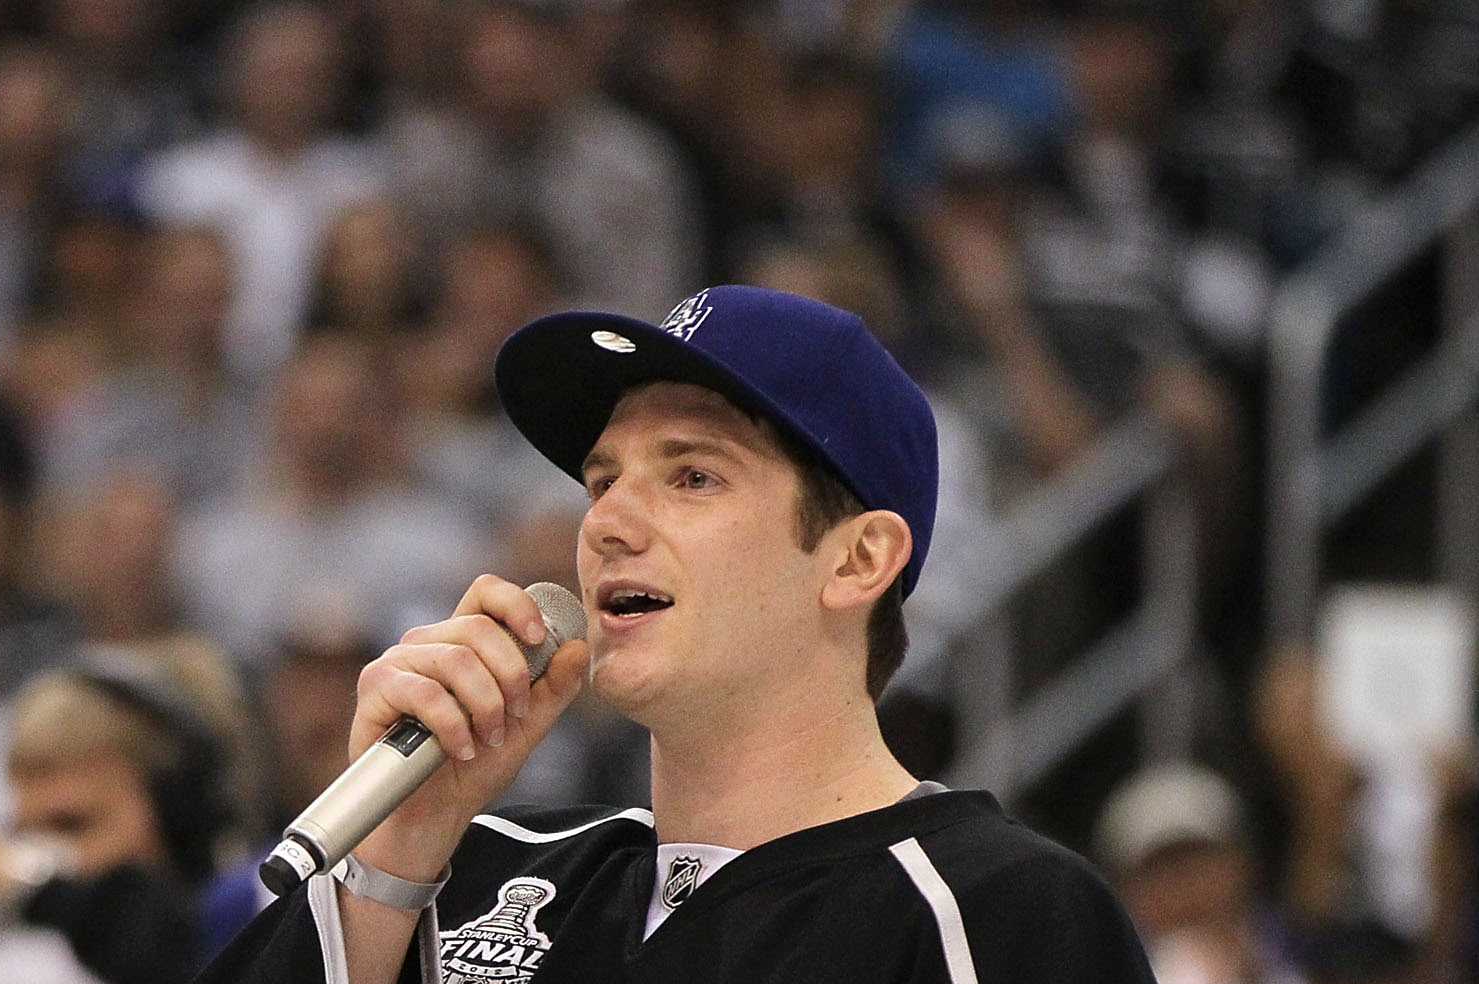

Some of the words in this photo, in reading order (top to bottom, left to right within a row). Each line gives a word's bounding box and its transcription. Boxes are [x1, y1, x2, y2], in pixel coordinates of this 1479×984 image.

[668, 869, 694, 898] NHL
[458, 930, 511, 942] STANLEY
[510, 937, 538, 946] CUP
[440, 940, 544, 968] FINAL
[459, 964, 503, 976] 2012
